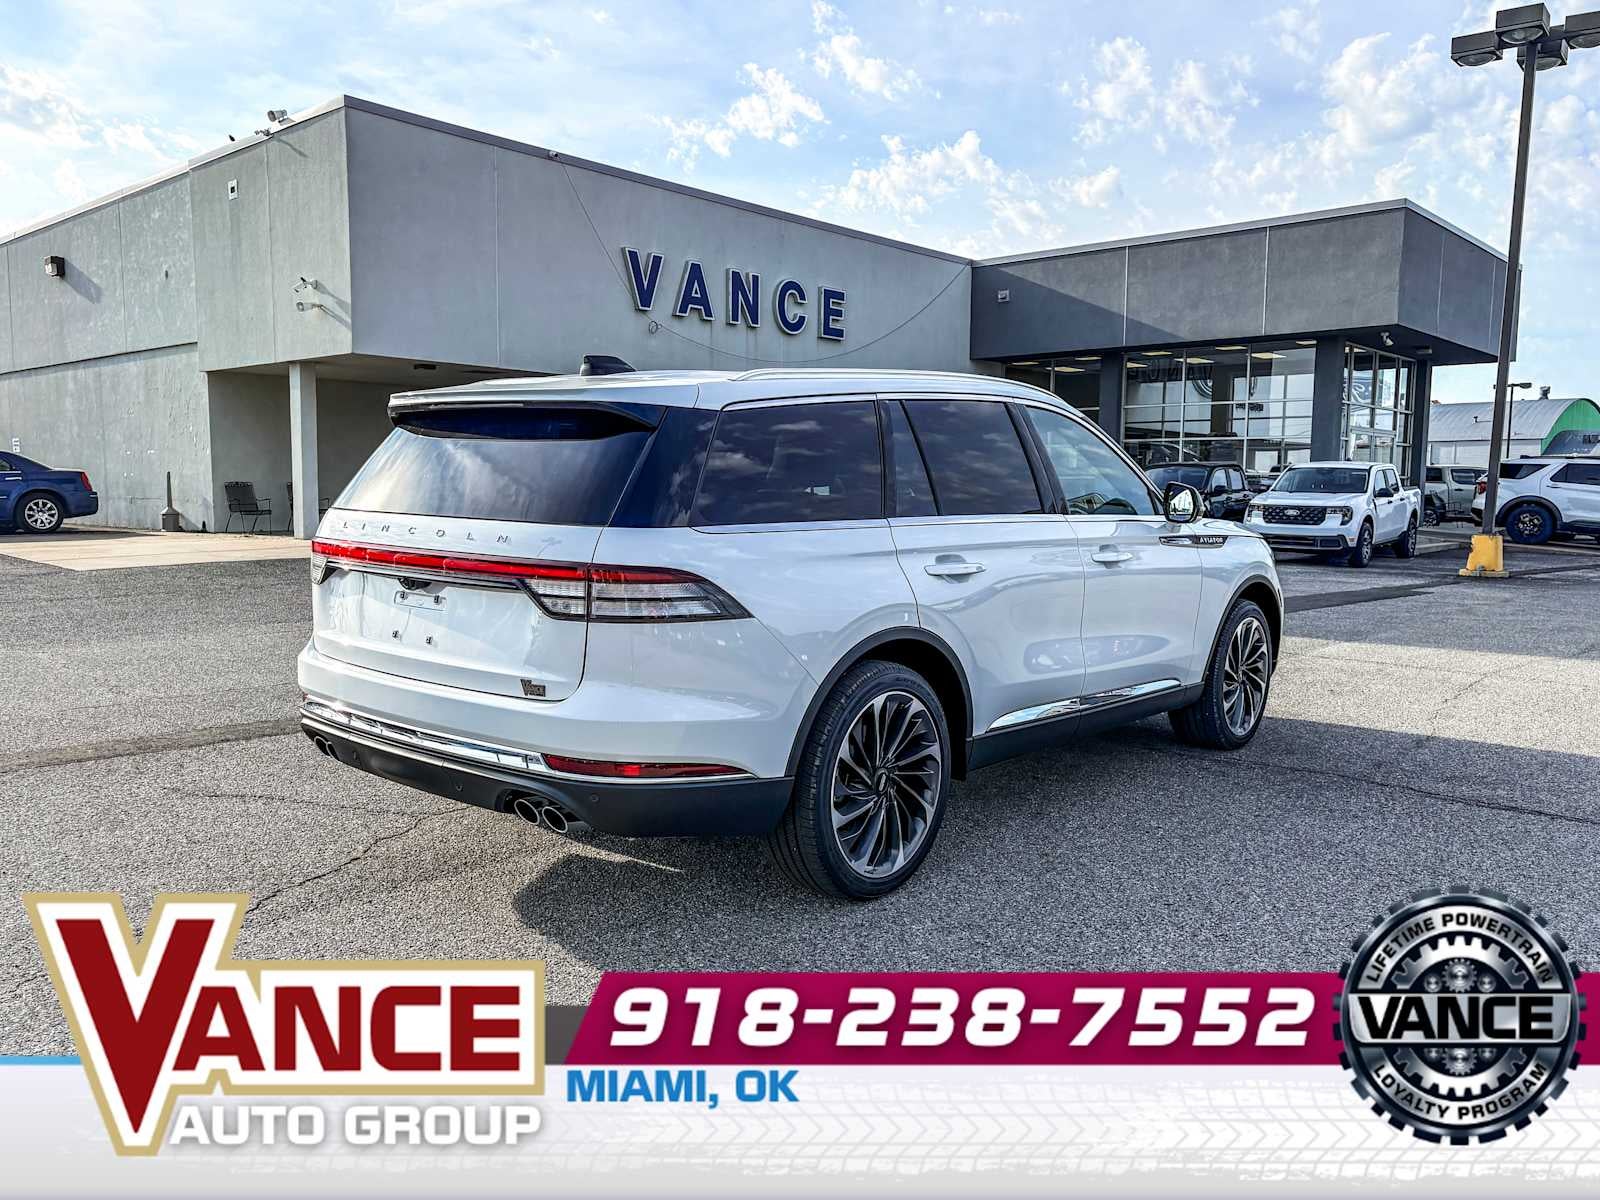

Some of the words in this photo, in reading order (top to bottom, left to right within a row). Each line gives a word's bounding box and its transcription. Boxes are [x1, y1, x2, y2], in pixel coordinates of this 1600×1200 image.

[621, 246, 847, 341] VANCE
[342, 521, 511, 545] LINCOLN
[1199, 536, 1224, 544] AVIATOR
